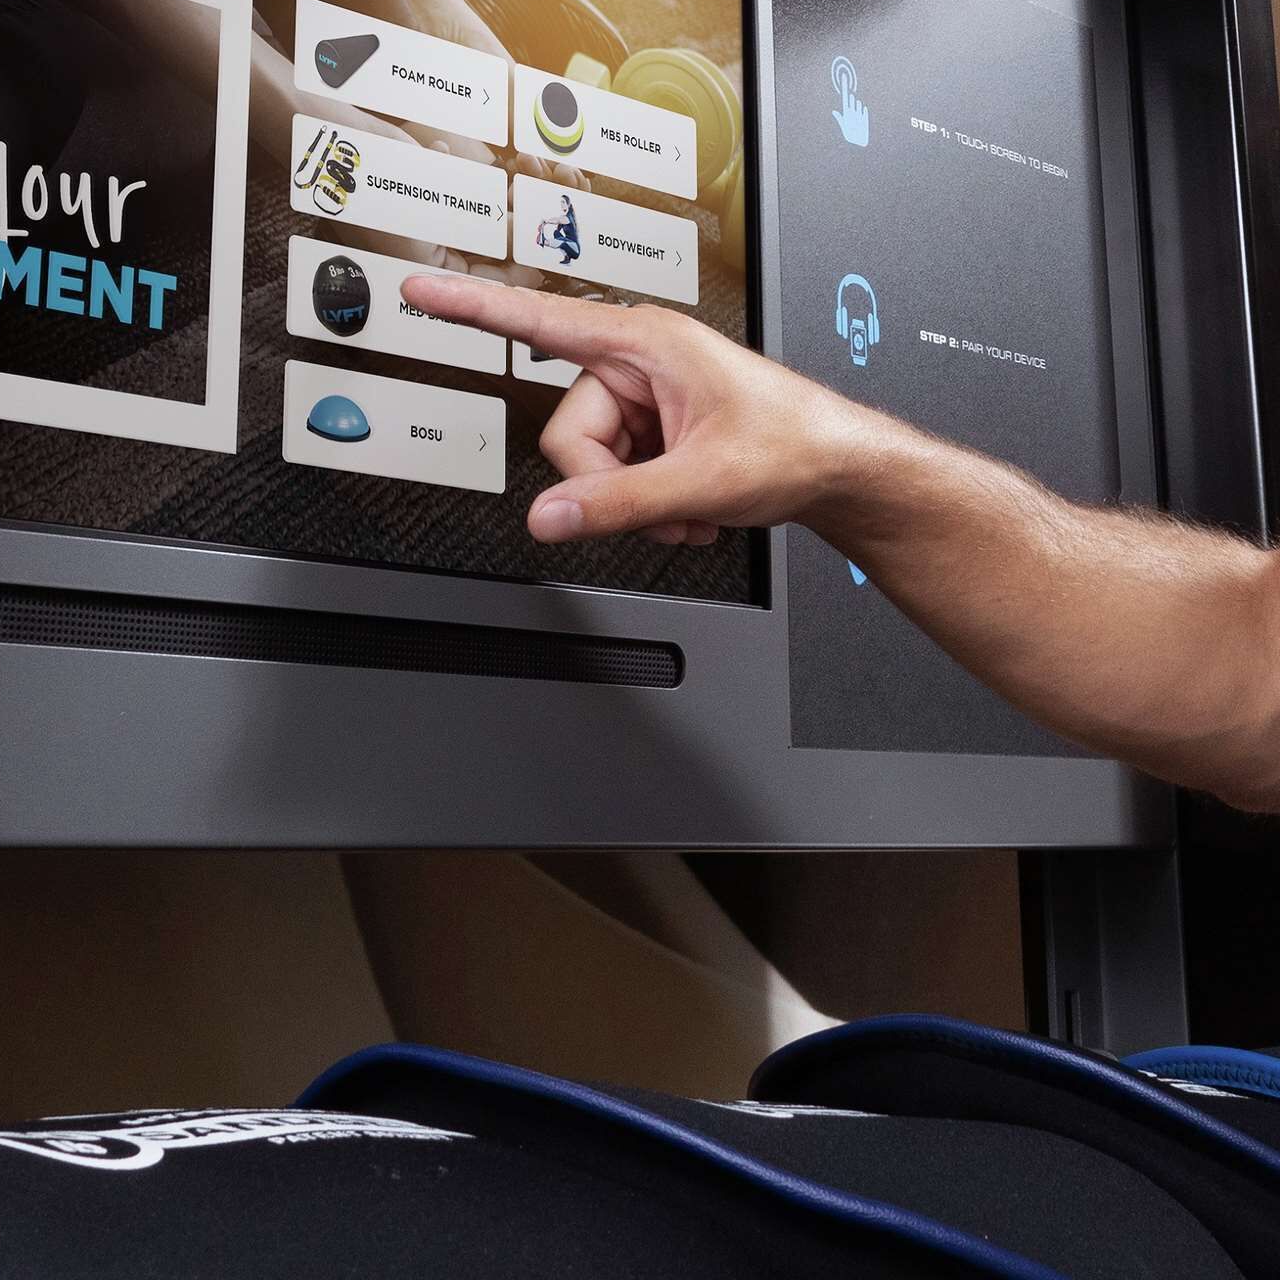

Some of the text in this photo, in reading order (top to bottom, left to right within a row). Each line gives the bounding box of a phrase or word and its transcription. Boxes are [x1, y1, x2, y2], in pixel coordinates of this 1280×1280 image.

[392, 65, 472, 99] FOAM ROLLER
[601, 127, 662, 155] MB5 ROLLER
[911, 117, 1069, 179] STEP 1: TOUCH SCREEN TO BEGIN
[366, 174, 491, 217] SUSPENSION TRAINER
[598, 234, 665, 261] BODYWEIGHT
[322, 305, 366, 323] LYFT
[920, 330, 1047, 370] STEP 2: PAIR YOUR DEVICE
[410, 425, 442, 442] BOSU
